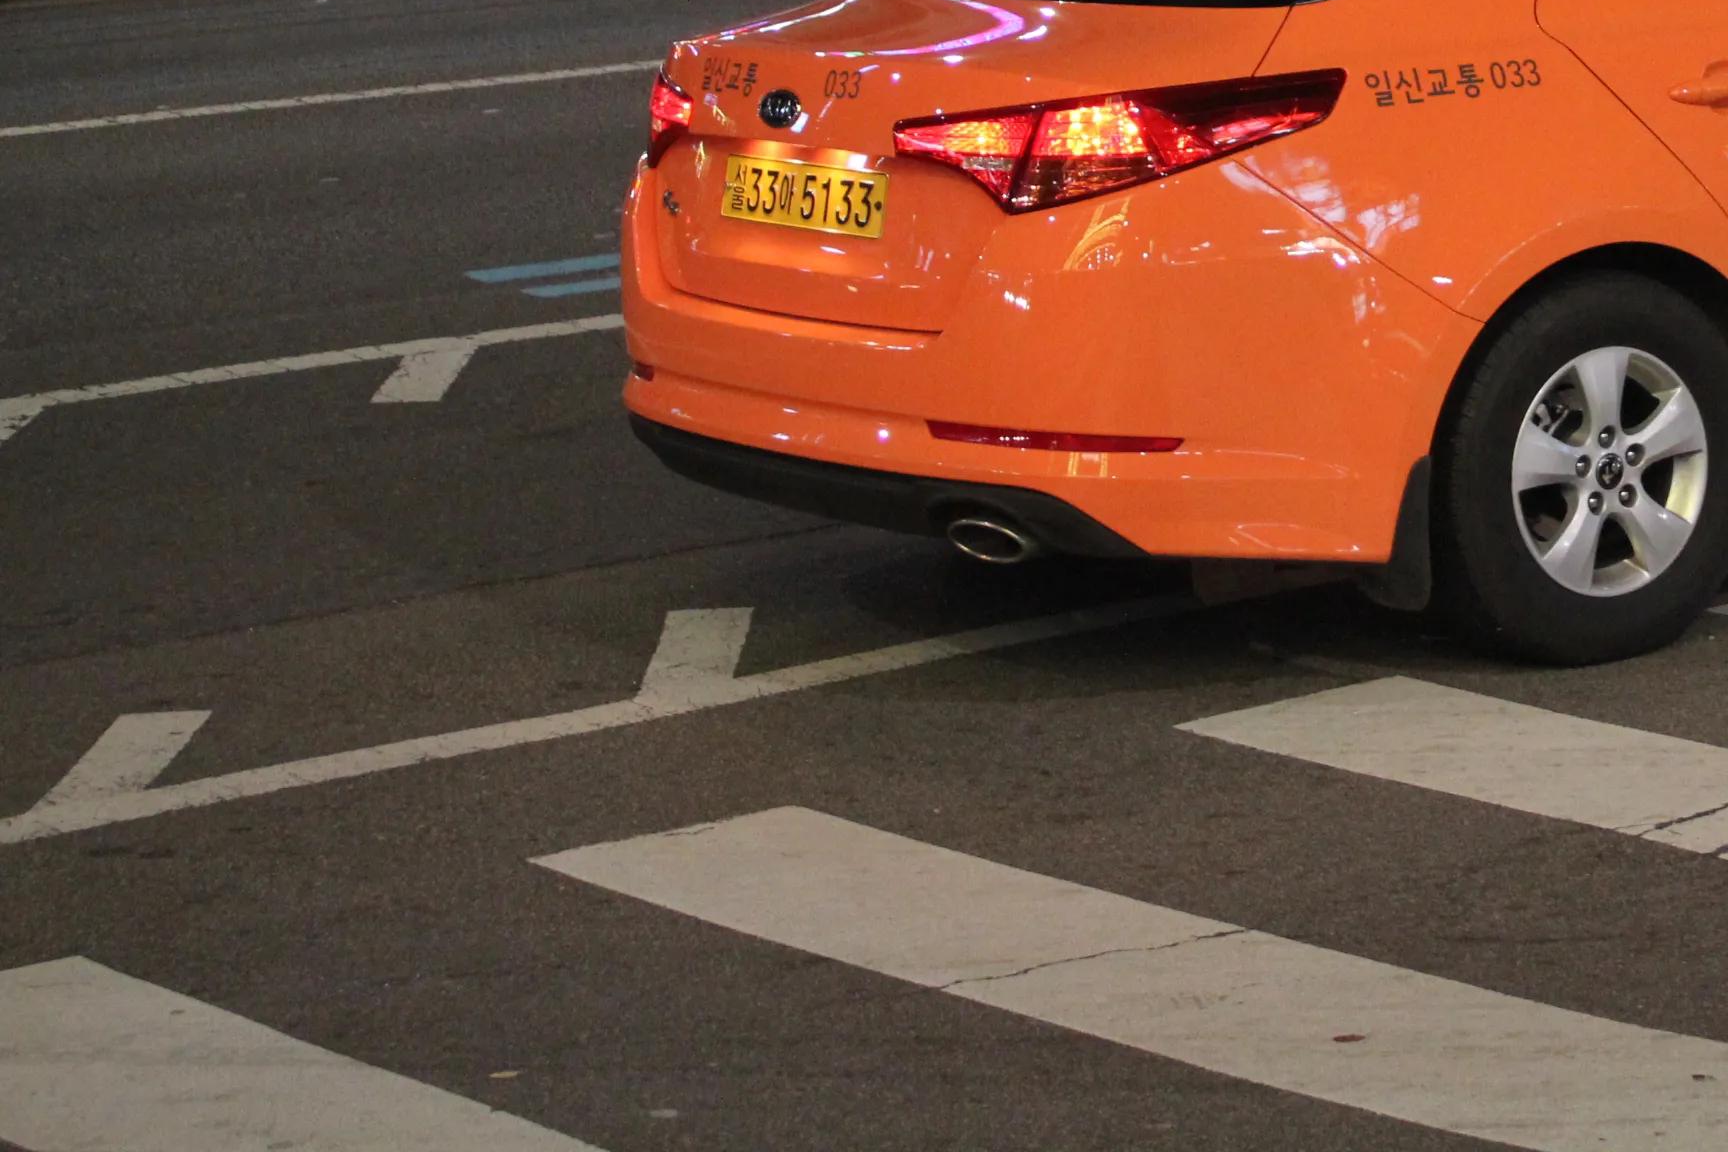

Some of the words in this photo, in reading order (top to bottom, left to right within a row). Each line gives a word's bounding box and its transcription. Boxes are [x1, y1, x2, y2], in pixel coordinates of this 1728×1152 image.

[702, 57, 758, 97] 일신교통
[824, 69, 862, 99] 033
[1364, 63, 1484, 107] 일신교통
[1490, 59, 1541, 89] 033
[731, 163, 748, 211] 서울
[747, 167, 796, 215] 33아
[800, 174, 875, 228] 5133
